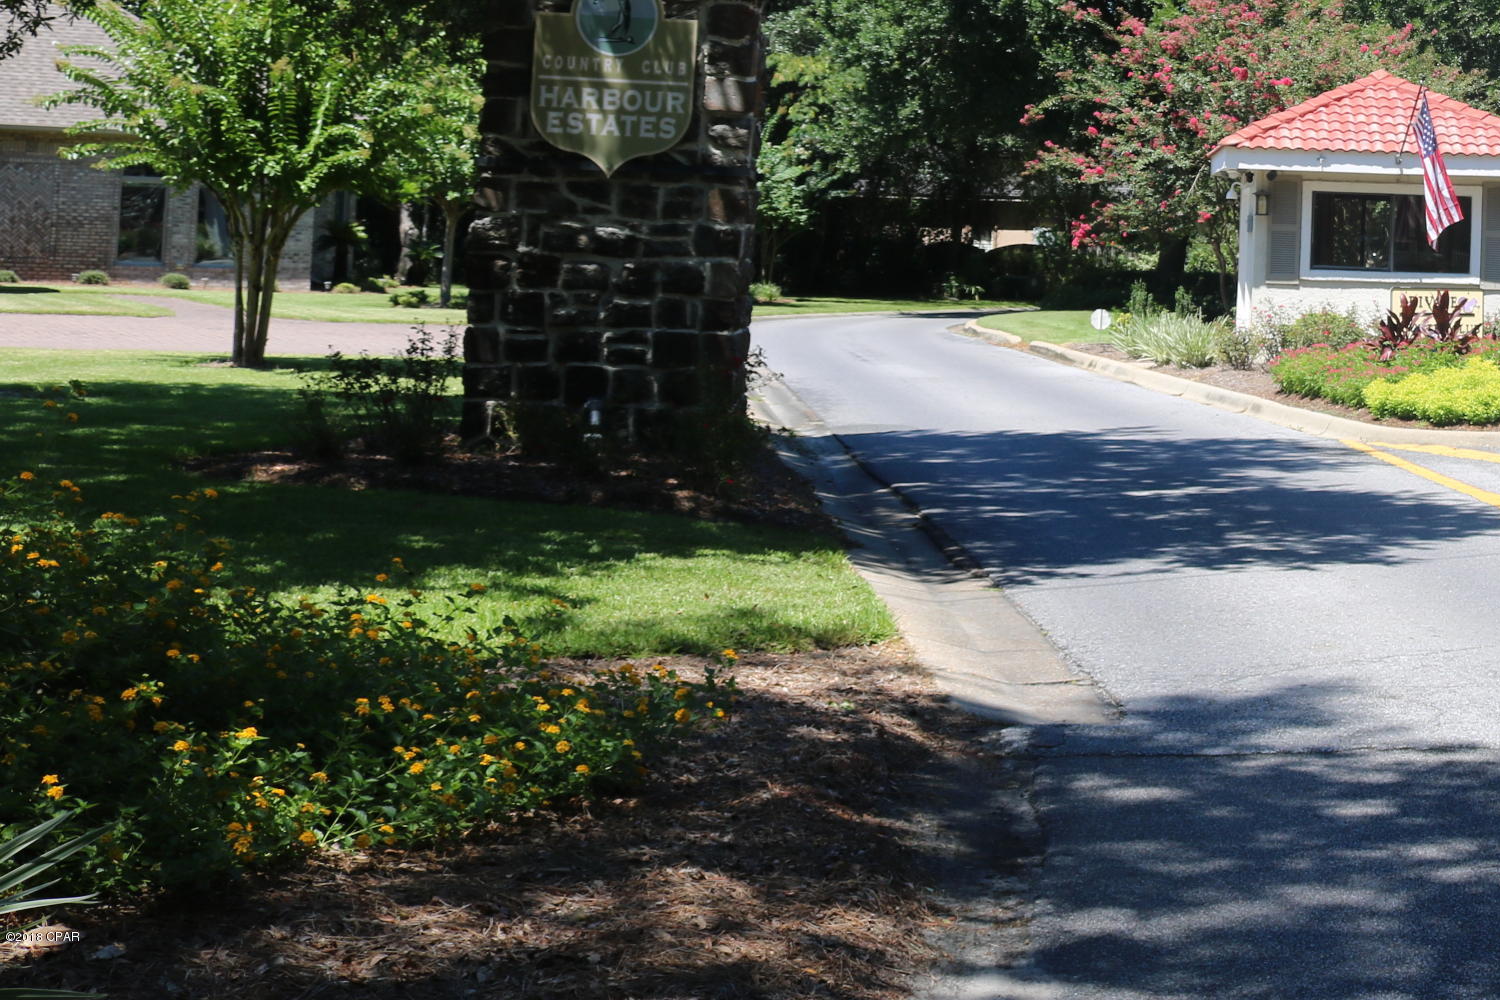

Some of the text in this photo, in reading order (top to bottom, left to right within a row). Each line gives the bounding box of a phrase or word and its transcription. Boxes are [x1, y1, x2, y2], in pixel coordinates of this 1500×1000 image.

[542, 54, 687, 75] COUNTRY CLUB
[539, 85, 685, 114] HARBOUR
[546, 111, 677, 139] ESTATES
